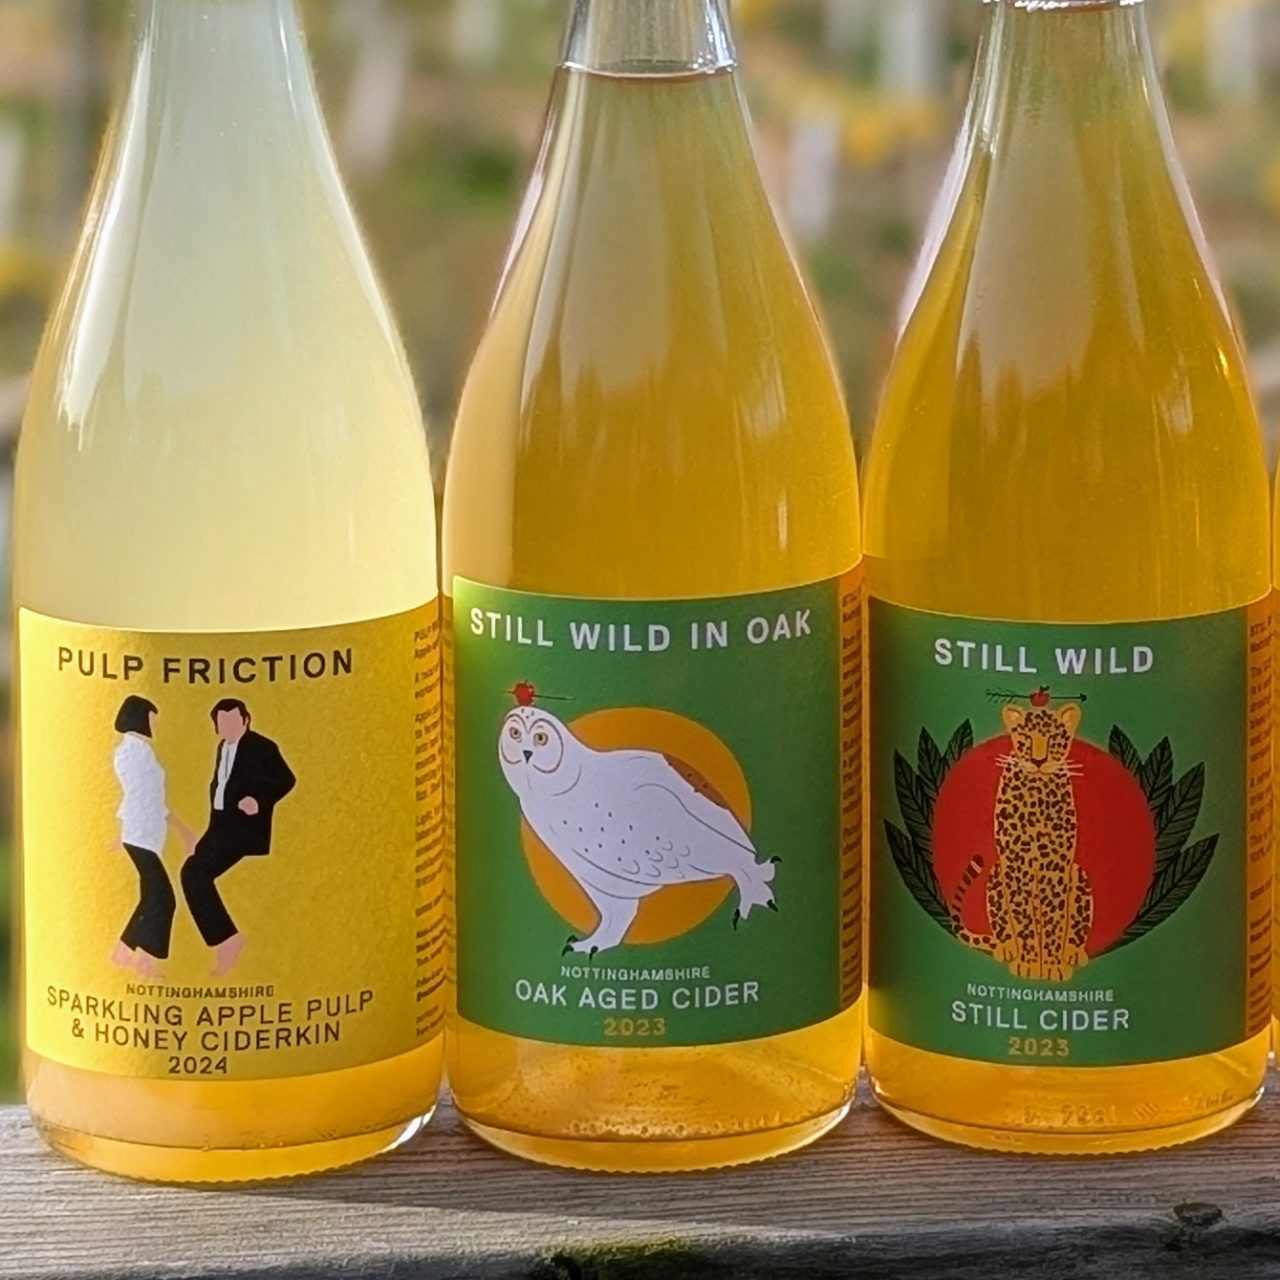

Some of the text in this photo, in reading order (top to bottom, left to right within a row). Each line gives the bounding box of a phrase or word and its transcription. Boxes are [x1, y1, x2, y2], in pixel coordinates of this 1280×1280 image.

[470, 607, 553, 647] STILL
[570, 623, 671, 652] WILD
[691, 620, 729, 649] IN
[746, 609, 813, 645] OAK
[58, 646, 353, 685] PULP FRICTION
[934, 638, 1154, 675] STILL WILD
[561, 965, 710, 981] NOTTINGHAMSHIRE
[126, 982, 274, 999] NOTTINGHAMSHIRE
[515, 980, 759, 1011] OAK AGED CIDER
[967, 983, 1114, 1002] NOTTINGHAMSHIRE
[47, 986, 374, 1027] SPARKLING APPLE PULP
[952, 1001, 1130, 1031] STILL CIDER
[71, 1020, 340, 1052] & HONEY CIDERKIN
[604, 1017, 666, 1037] 2023
[1009, 1036, 1070, 1056] 2023
[168, 1056, 228, 1075] 2024
